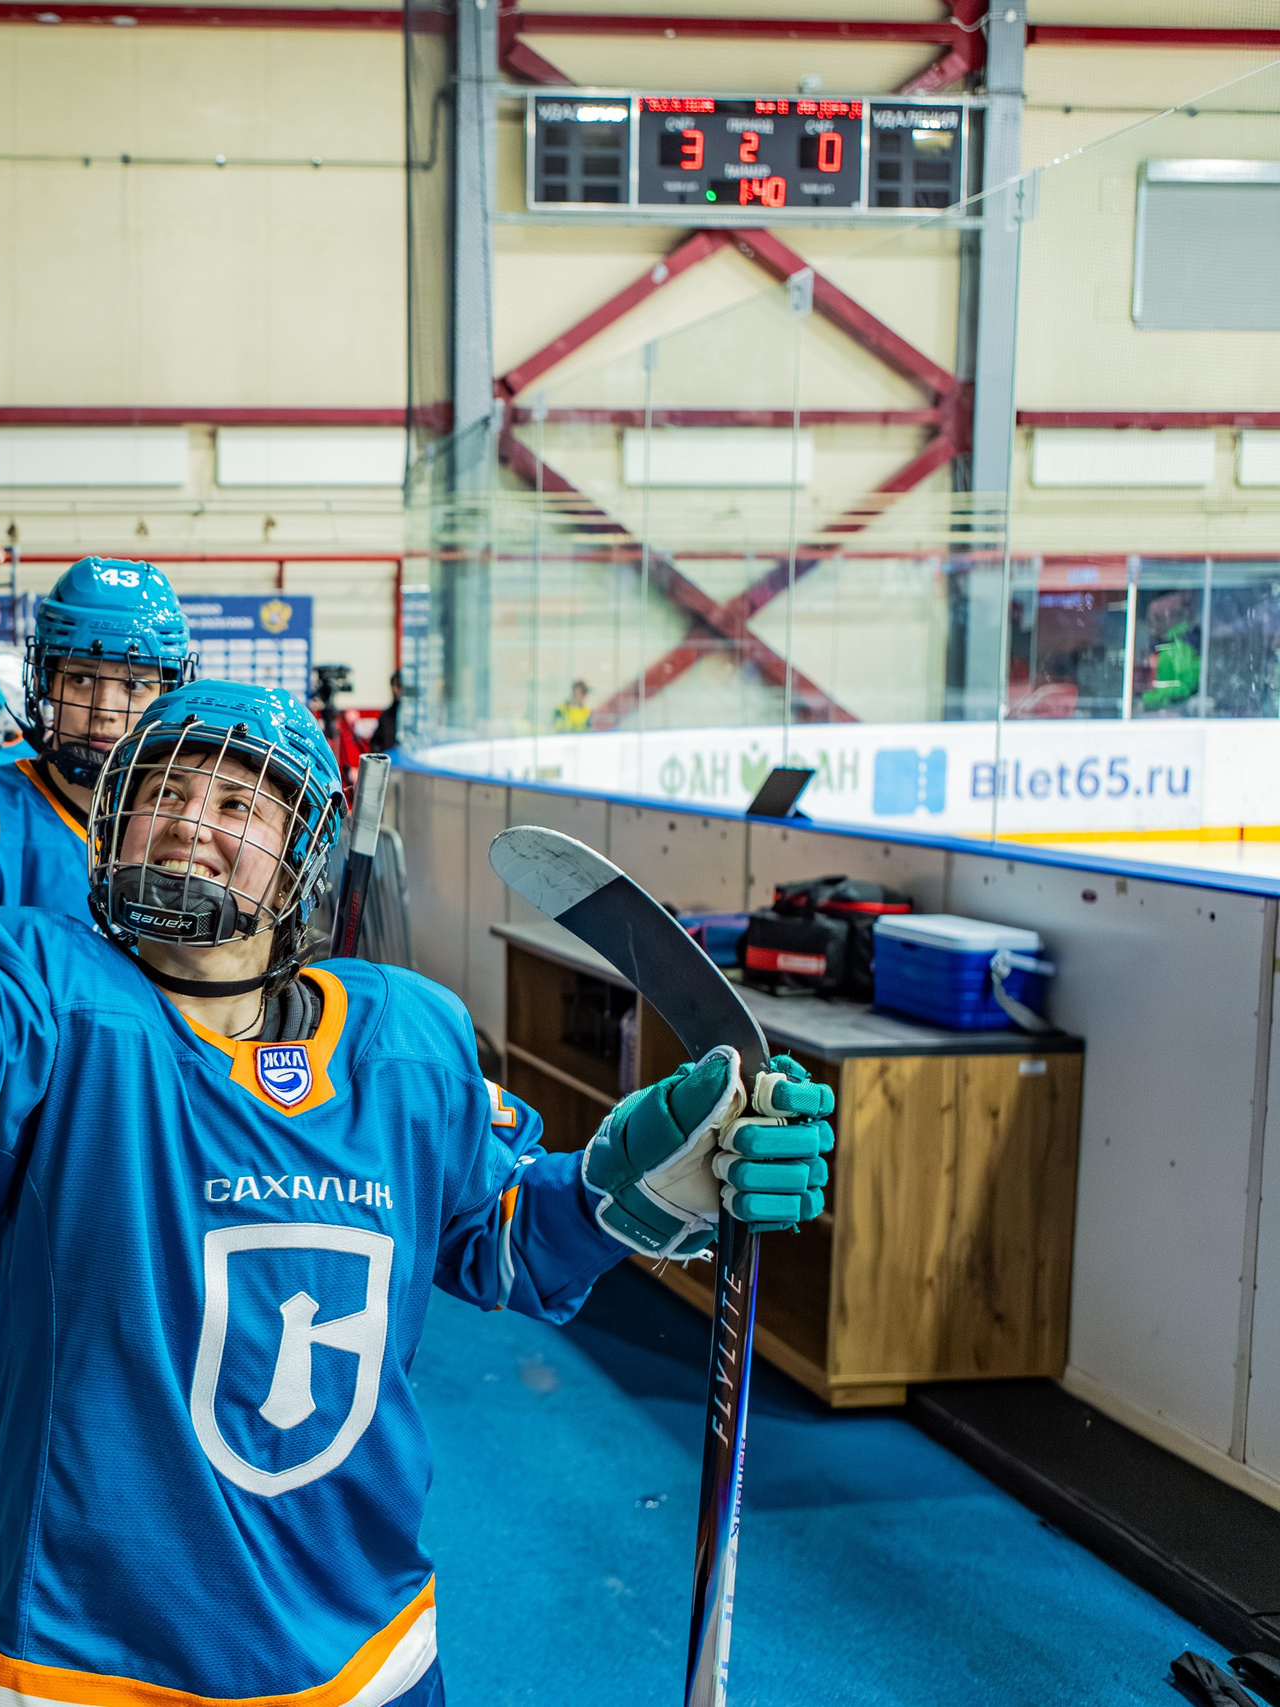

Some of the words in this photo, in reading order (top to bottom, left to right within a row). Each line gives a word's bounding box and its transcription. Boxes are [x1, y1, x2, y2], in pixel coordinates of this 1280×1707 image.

[680, 128, 704, 170] 3
[739, 131, 759, 163] 2
[818, 132, 843, 173] 0
[100, 569, 140, 587] 43
[660, 752, 730, 797] ФАН
[971, 756, 1191, 800] Bilet65.ru
[130, 910, 193, 930] BAUER
[343, 891, 361, 950] BAUER
[263, 1051, 305, 1068] ЖХЛ
[204, 1174, 394, 1210] САХАЛИН
[712, 1265, 743, 1449] FLYLITE
